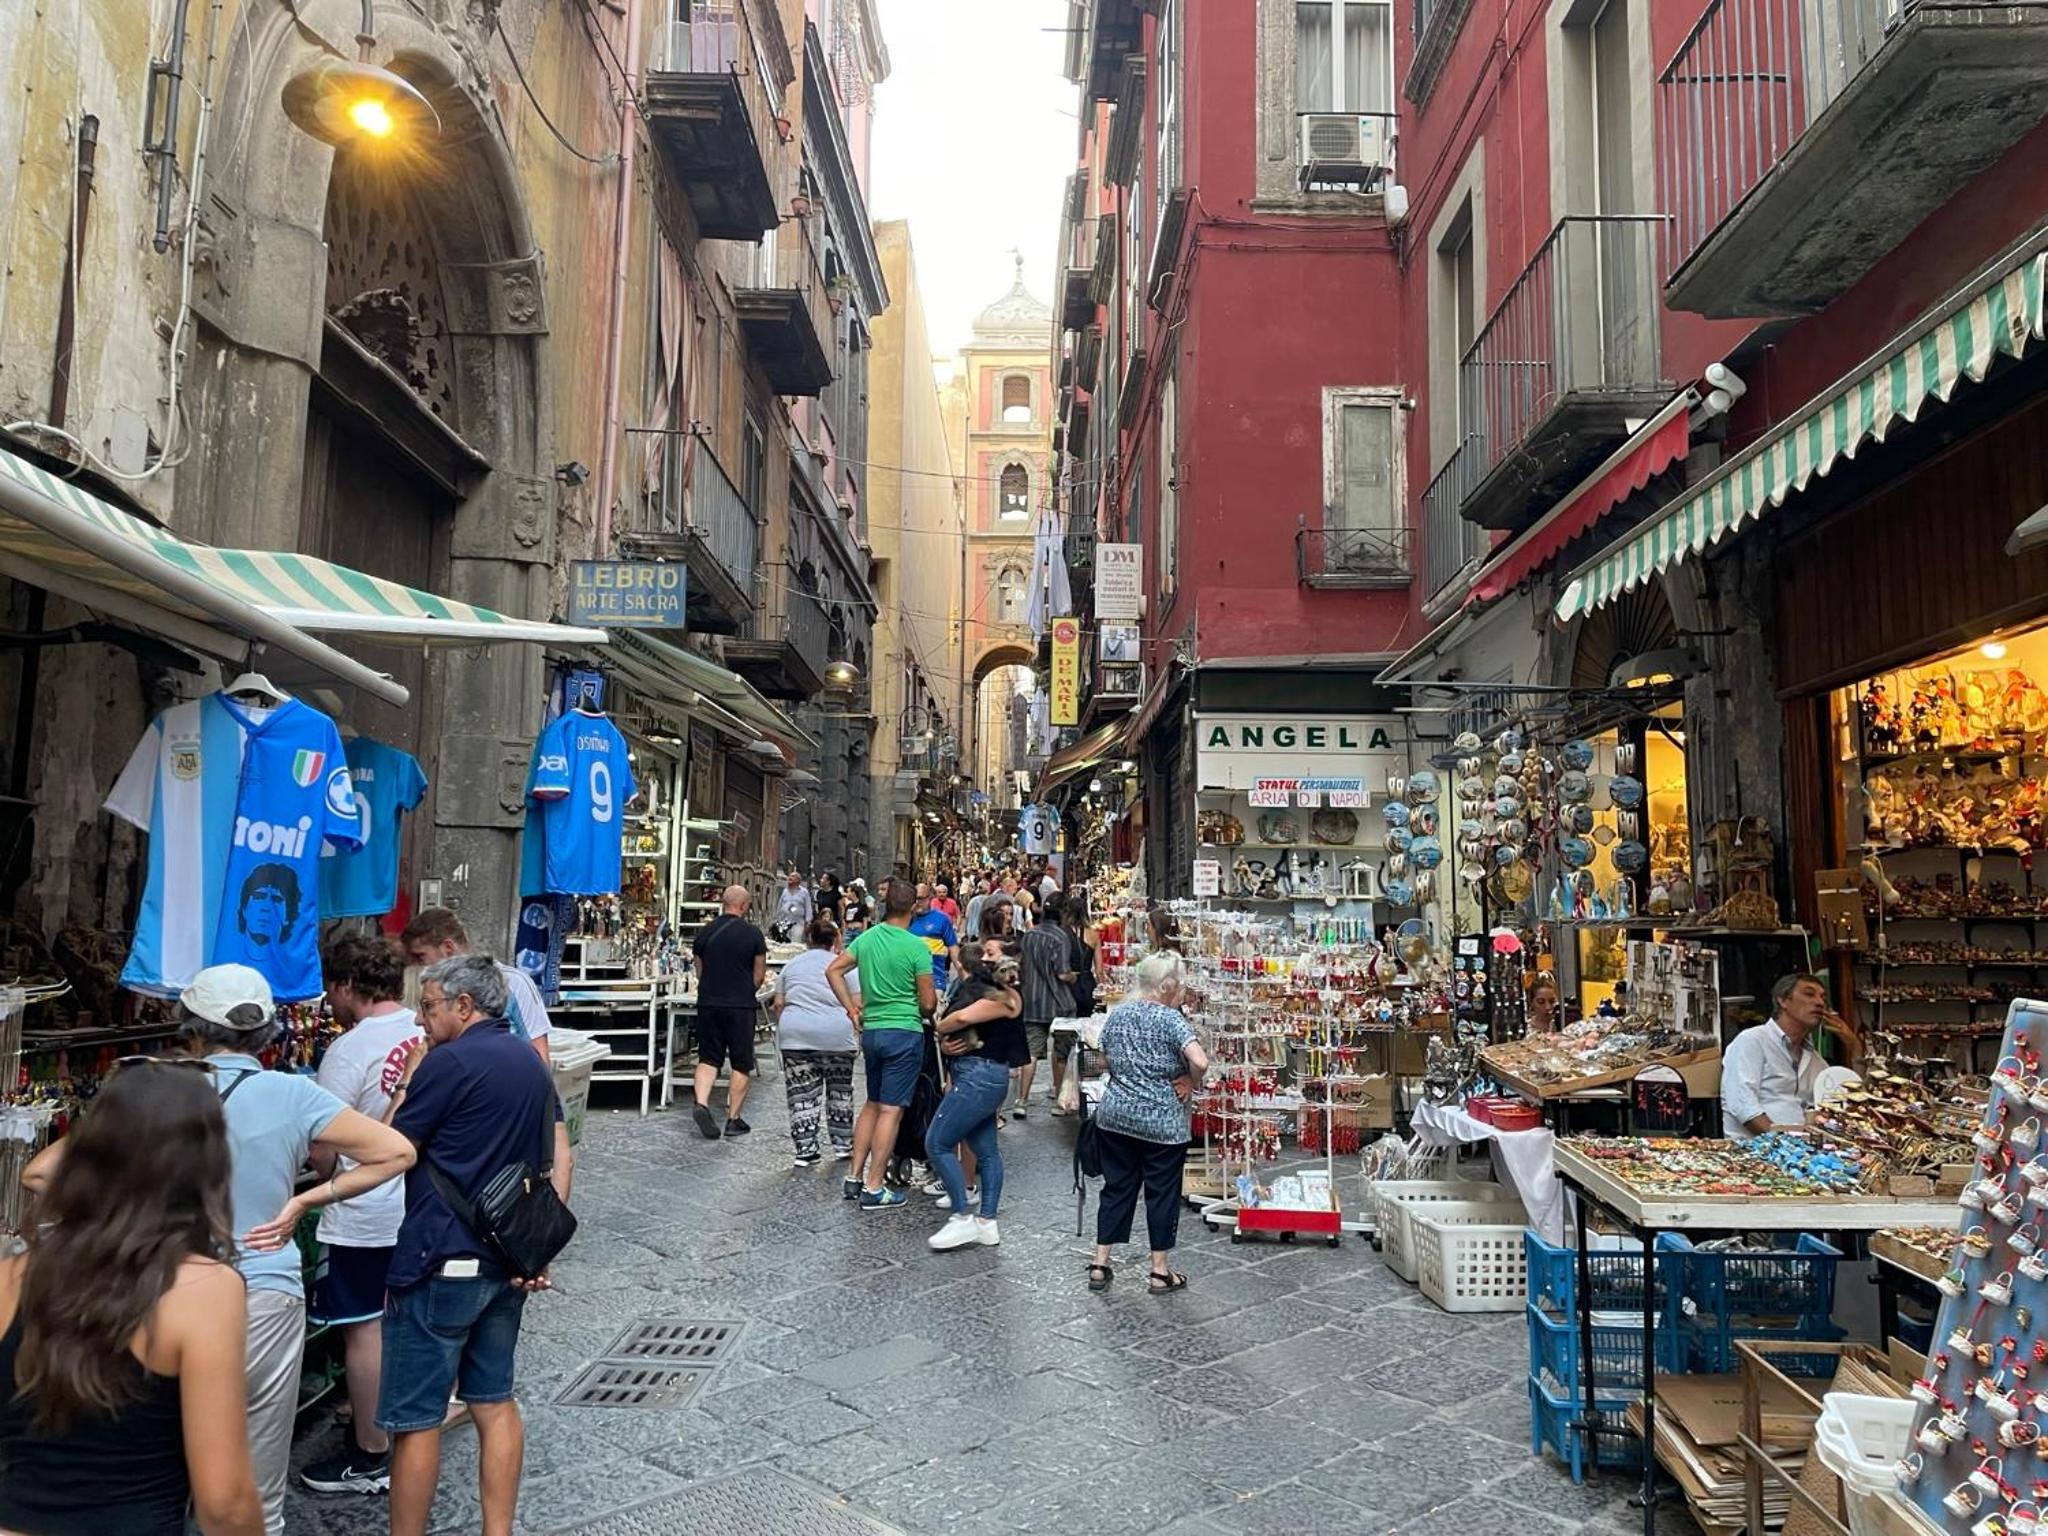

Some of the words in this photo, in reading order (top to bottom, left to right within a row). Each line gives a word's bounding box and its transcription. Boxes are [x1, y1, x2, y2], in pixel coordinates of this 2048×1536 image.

[576, 566, 679, 589] LEBRO
[576, 593, 619, 609] ARTE
[624, 594, 678, 610] SACRA
[1208, 726, 1392, 748] ANGELA
[590, 761, 613, 823] 9
[1258, 780, 1298, 790] STATUE
[1250, 792, 1289, 805] ARIA
[1331, 792, 1369, 806] NAPOLI
[1034, 821, 1044, 840] 9
